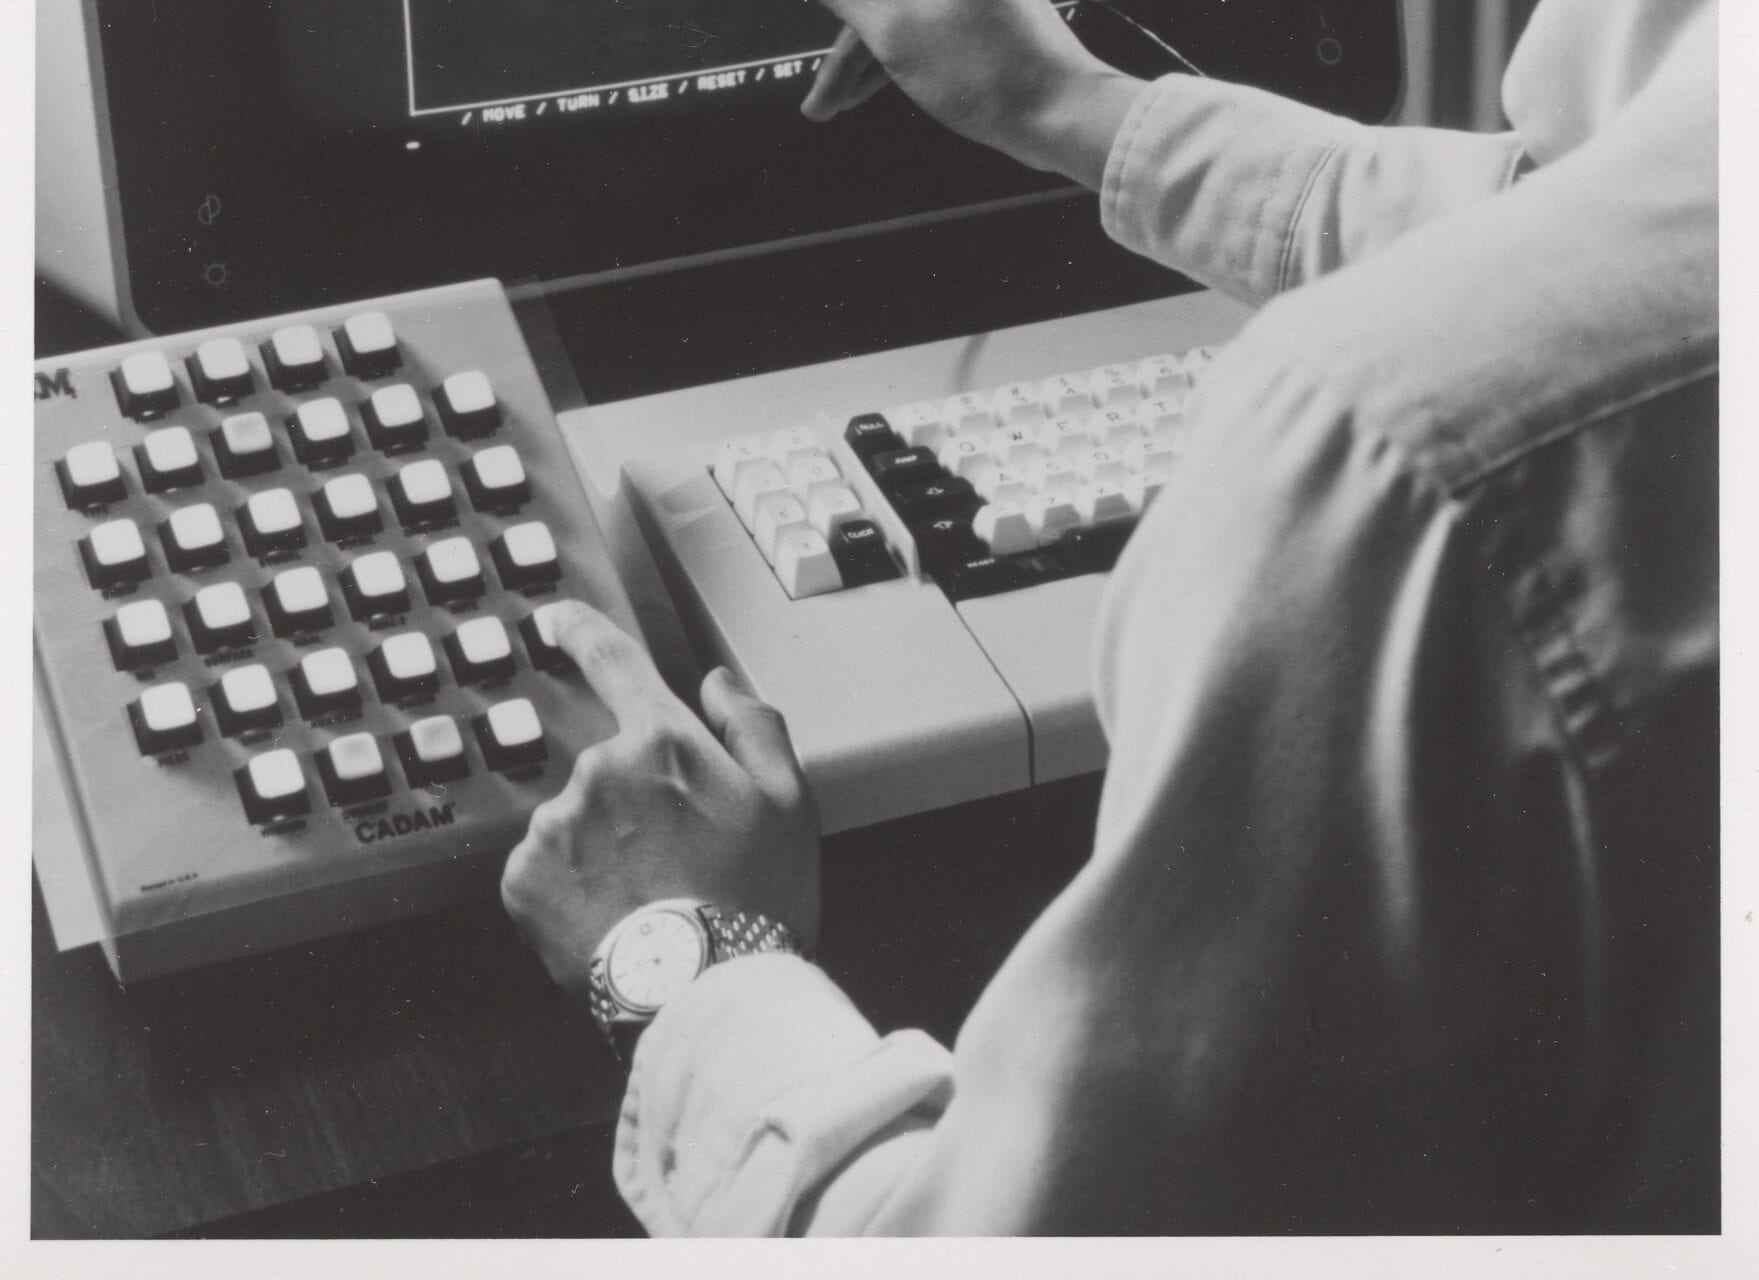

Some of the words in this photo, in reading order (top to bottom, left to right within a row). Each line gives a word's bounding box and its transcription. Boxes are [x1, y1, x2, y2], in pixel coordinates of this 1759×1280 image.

[482, 104, 526, 123] MOVE
[557, 94, 600, 111] TURN
[628, 82, 669, 103] SIZE
[697, 70, 747, 91] RESET
[774, 60, 803, 79] SET
